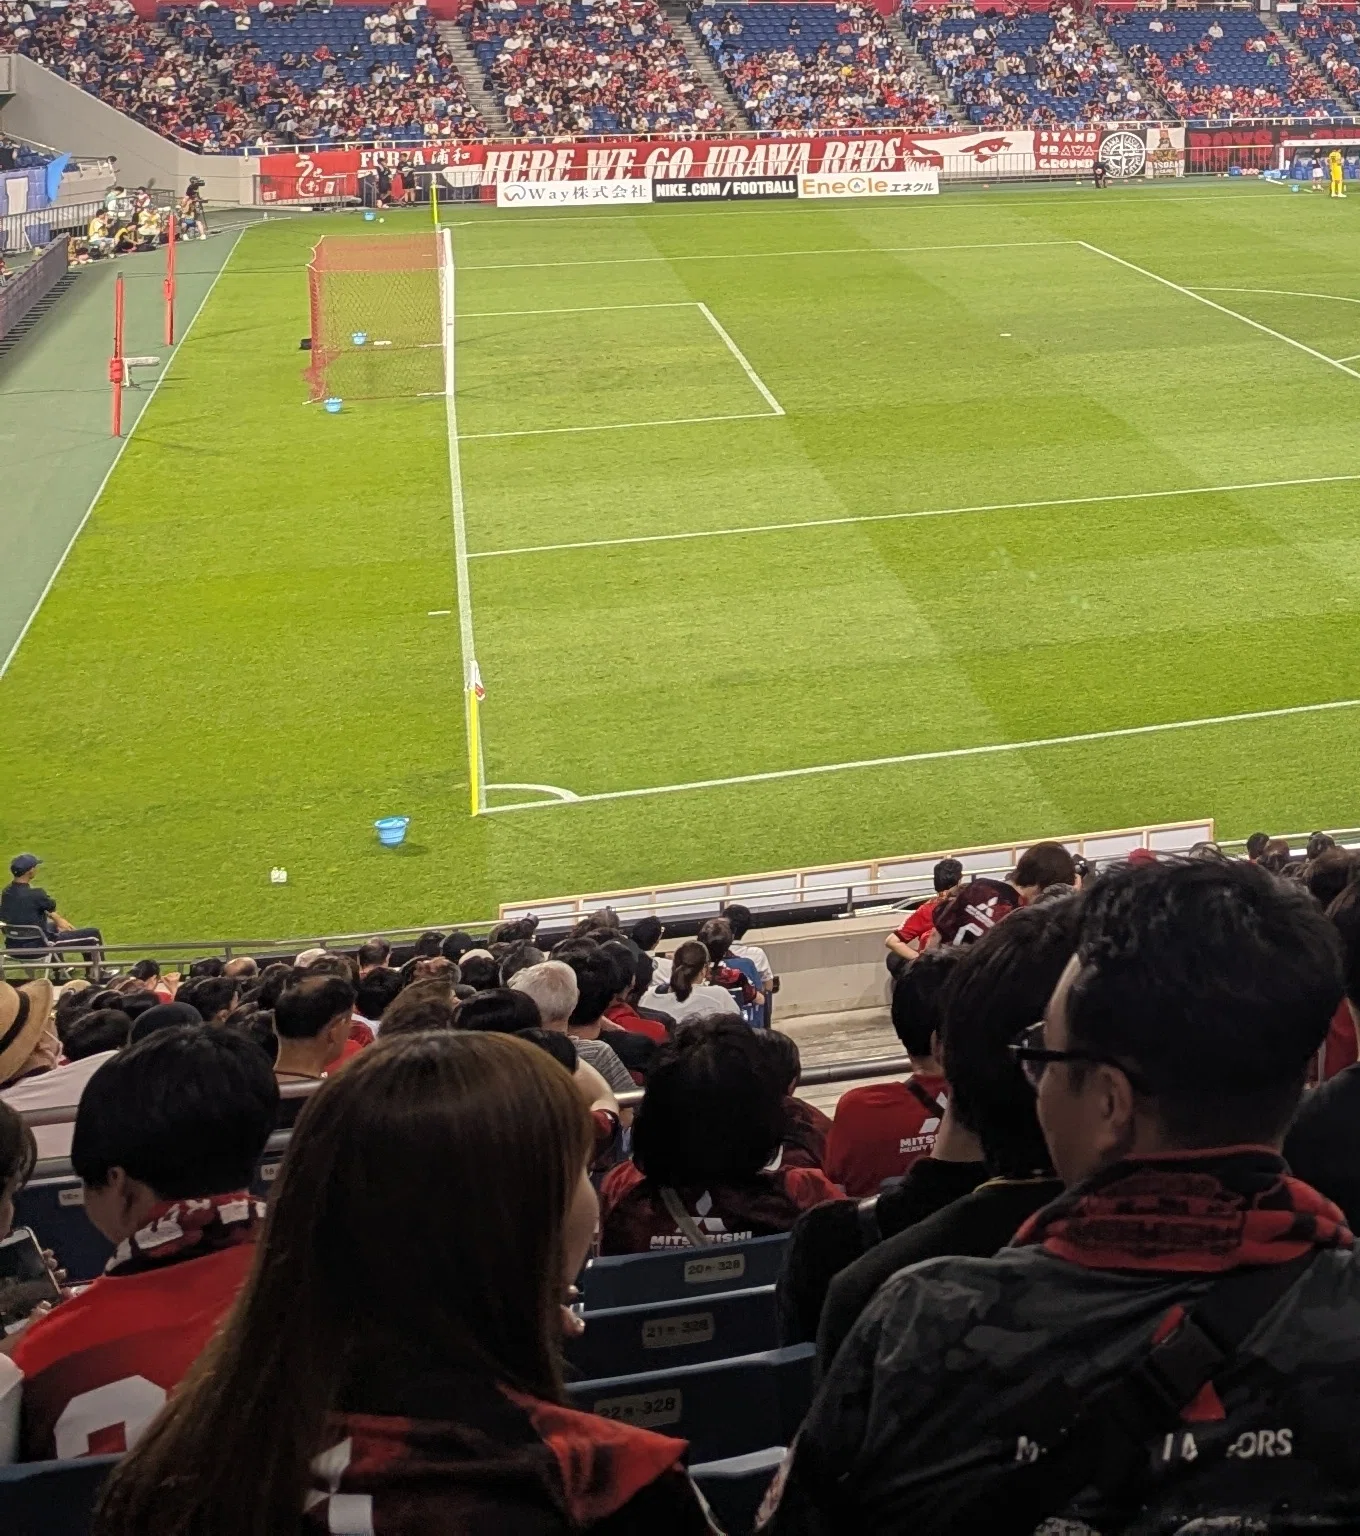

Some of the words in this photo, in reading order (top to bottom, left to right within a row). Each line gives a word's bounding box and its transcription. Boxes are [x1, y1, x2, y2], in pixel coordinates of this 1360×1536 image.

[1039, 131, 1098, 143] STAND
[360, 151, 427, 167] FORA
[481, 149, 575, 185] HERE
[586, 147, 638, 180] WE
[645, 145, 694, 180] GO
[702, 141, 813, 178] URAWA
[819, 137, 902, 174] REDS
[1038, 158, 1096, 169] GROUND
[889, 182, 936, 193] エネクル
